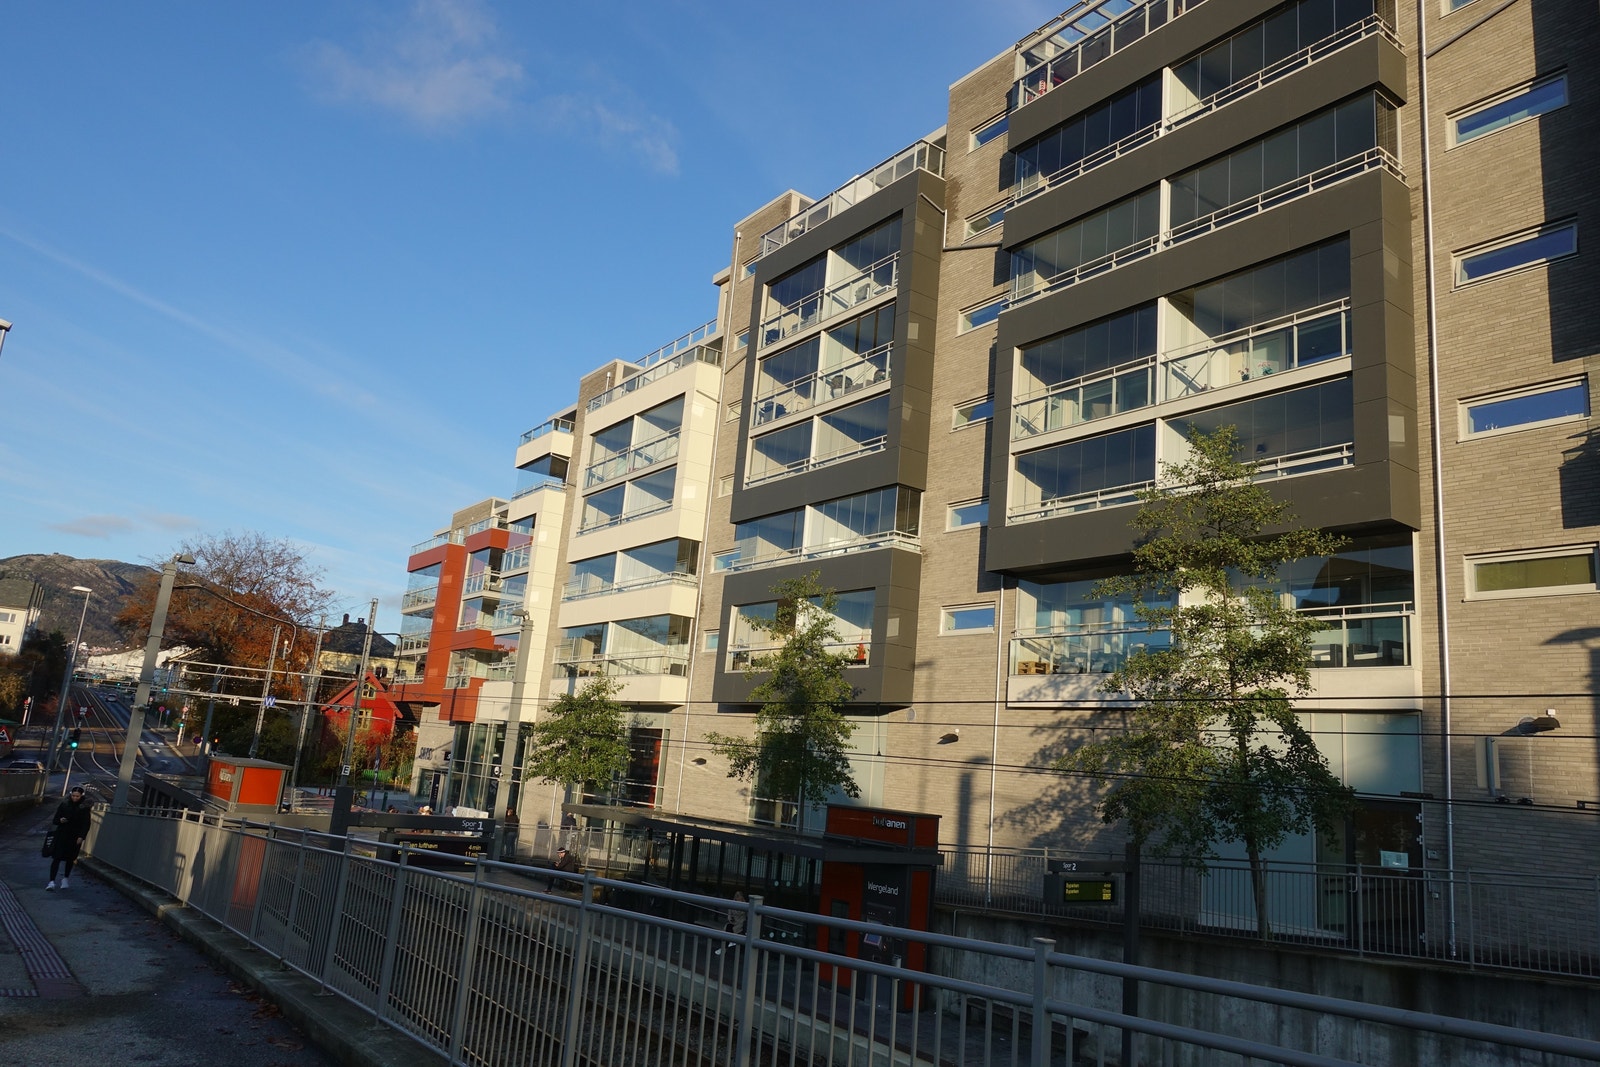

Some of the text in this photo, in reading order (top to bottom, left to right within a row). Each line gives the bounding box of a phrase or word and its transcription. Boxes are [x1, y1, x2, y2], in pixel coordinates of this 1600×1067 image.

[265, 697, 275, 706] W
[342, 765, 350, 775] E
[461, 819, 477, 828] Spor
[477, 821, 484, 830] 1
[1072, 862, 1077, 871] 2
[867, 881, 899, 896] Wergeland
